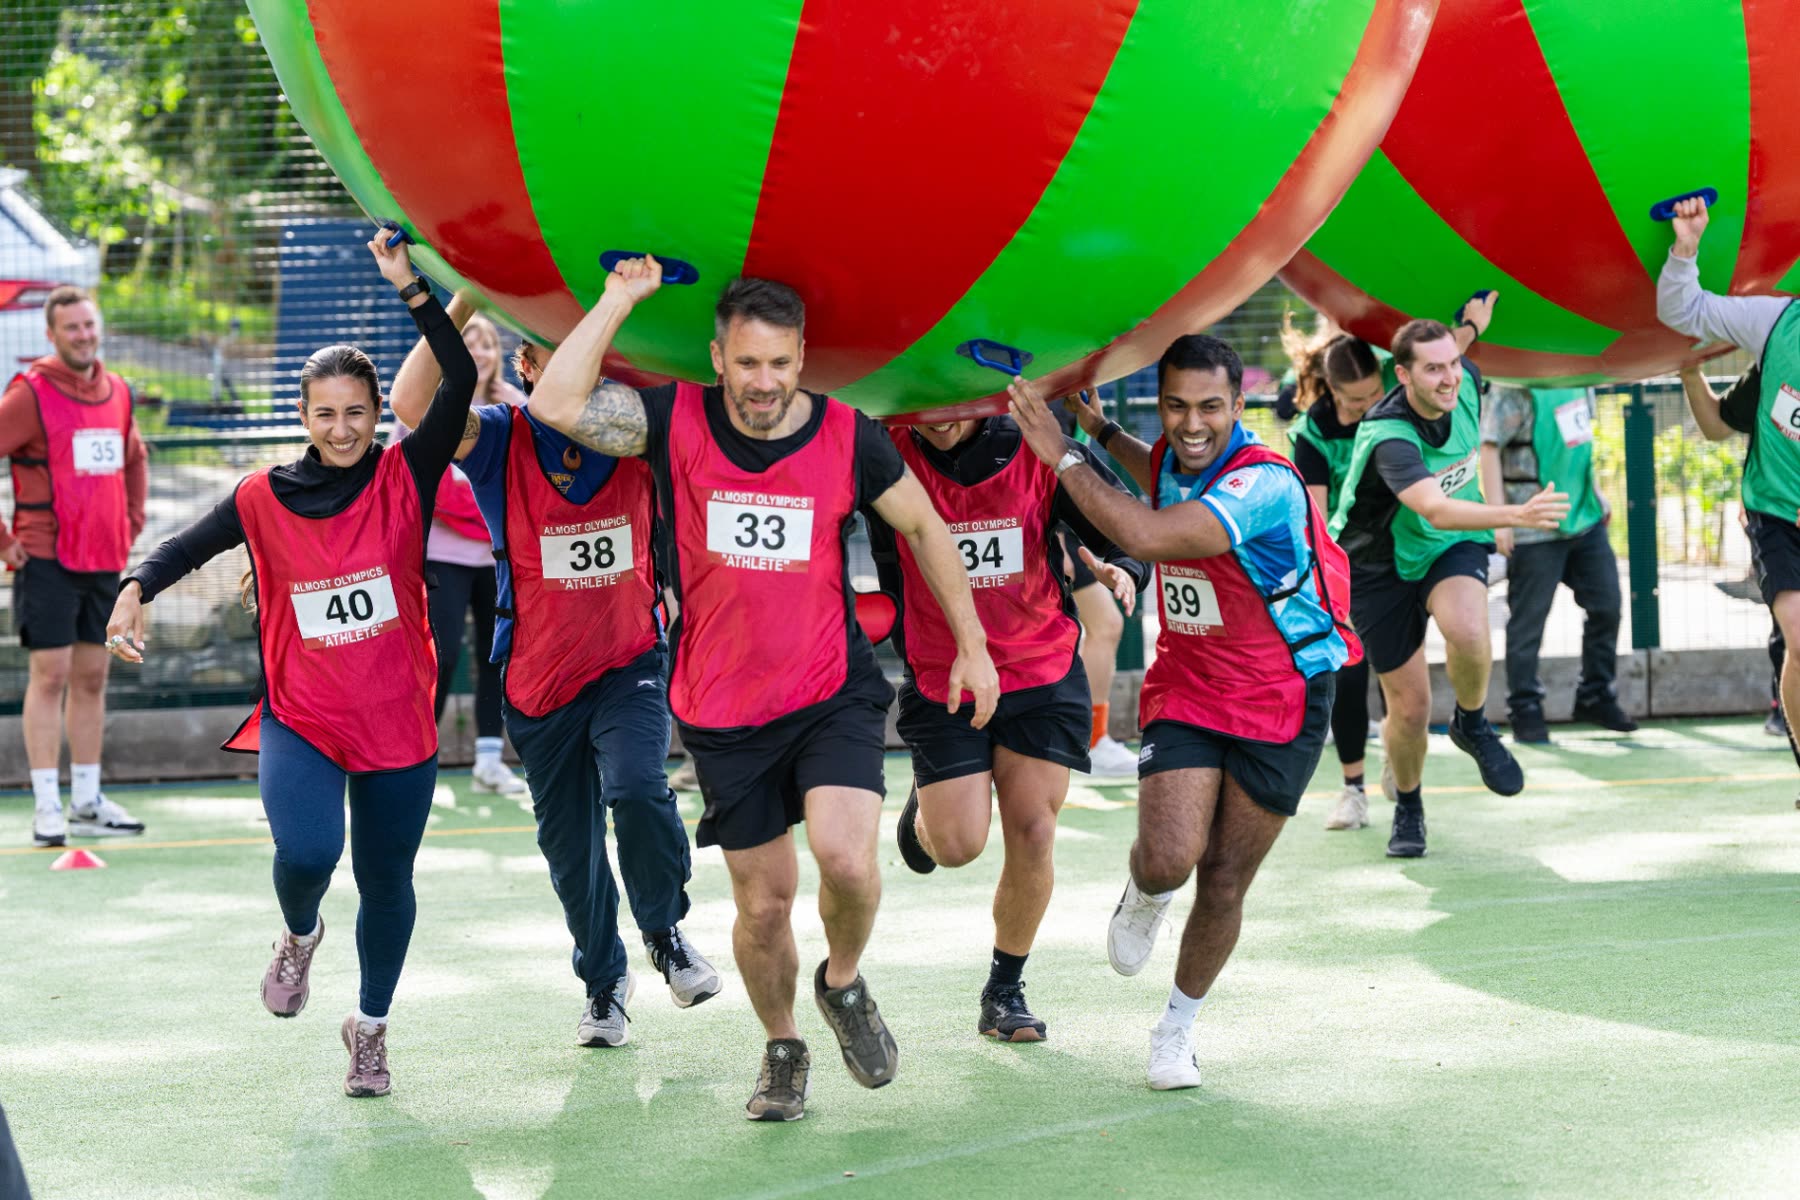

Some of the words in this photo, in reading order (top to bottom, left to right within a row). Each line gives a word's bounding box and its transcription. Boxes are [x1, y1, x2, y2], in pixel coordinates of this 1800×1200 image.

[91, 440, 116, 462] 35
[1440, 467, 1467, 493] 62
[712, 490, 754, 504] ALMOST
[756, 492, 808, 508] OLYMPICS
[543, 523, 582, 535] ALMOST
[584, 515, 627, 532] OLYMPICS
[734, 512, 786, 551] 33
[971, 517, 1017, 531] OLYMPICS
[569, 535, 616, 572] 38
[721, 553, 791, 572] "ATHLETE"
[957, 536, 1004, 572] 34
[293, 579, 331, 593] ALMOST
[334, 565, 383, 587] OLYMPICS
[559, 573, 621, 591] "ATHLETE"
[325, 588, 374, 625] 40
[1164, 582, 1201, 618] 39
[318, 623, 384, 648] "ATHLETE"
